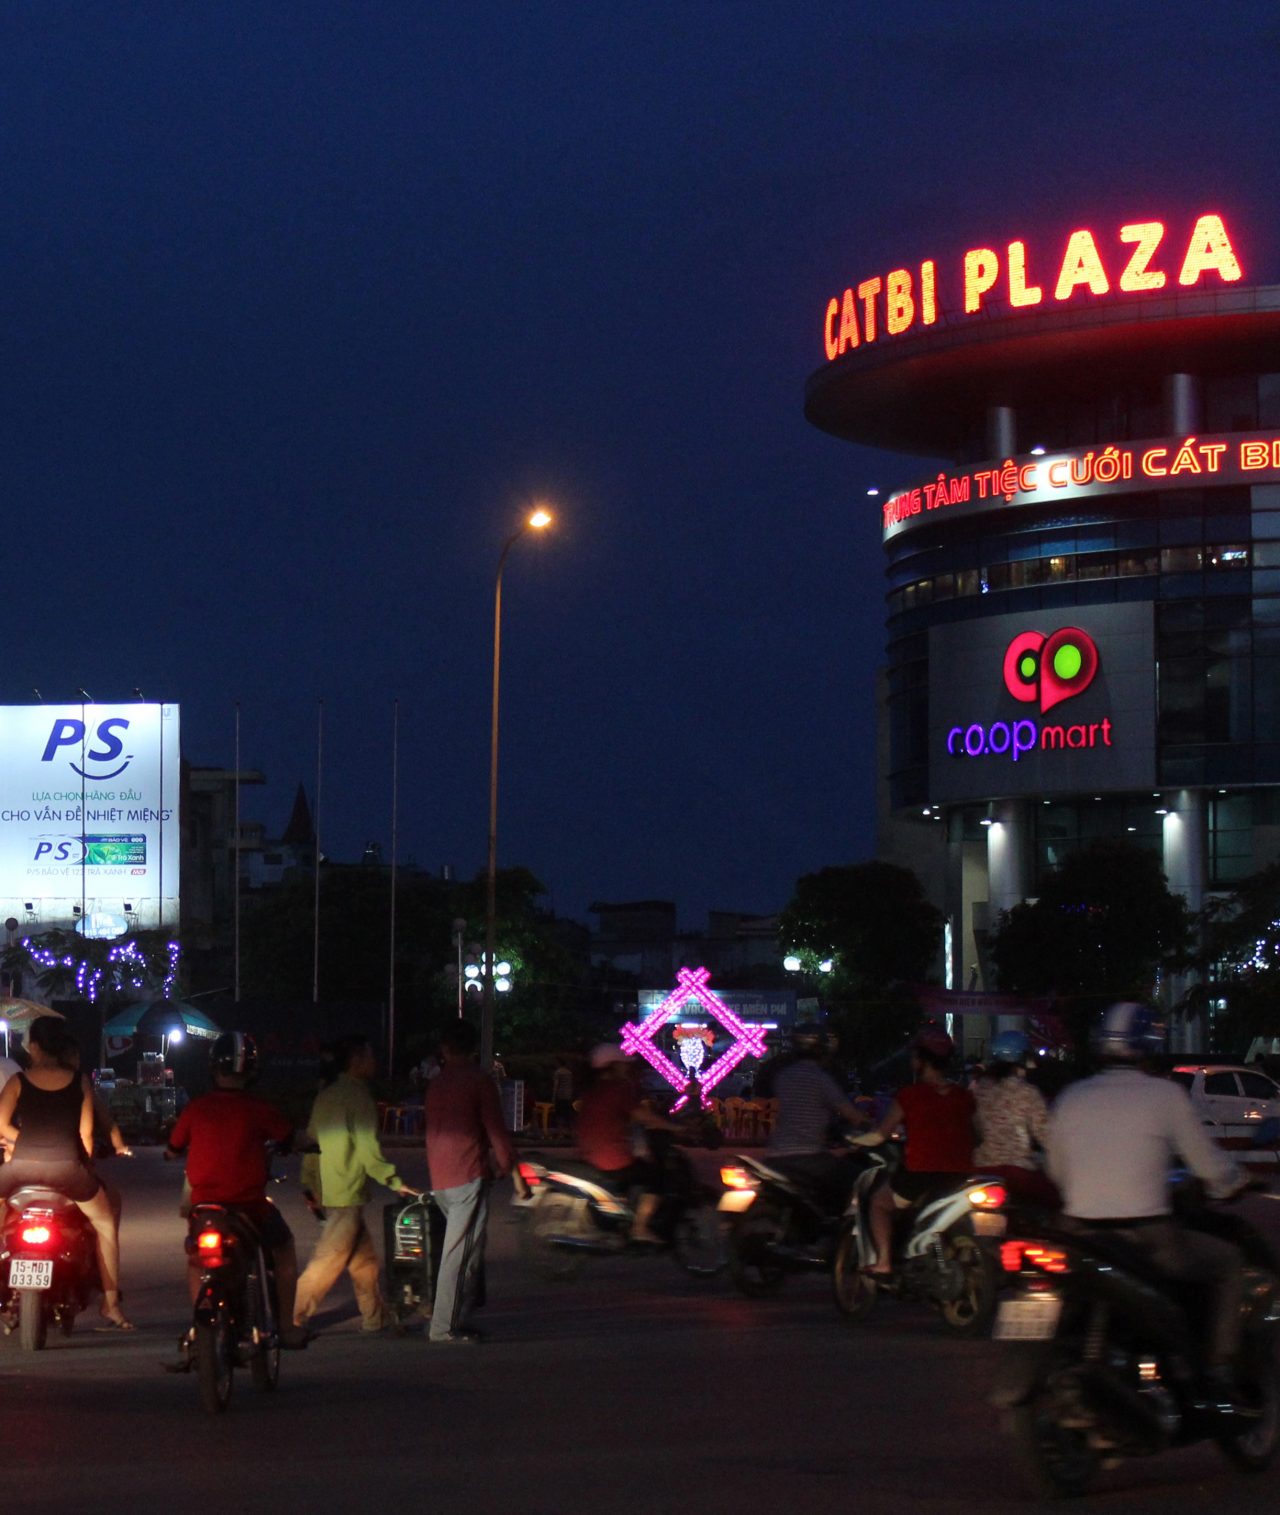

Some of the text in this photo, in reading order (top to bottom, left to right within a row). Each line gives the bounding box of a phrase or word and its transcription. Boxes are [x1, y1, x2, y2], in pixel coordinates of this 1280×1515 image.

[825, 214, 1242, 360] CATBI PLAZA
[883, 437, 1280, 528] TRUNG TÂM TIỆC CƯỚI CÁT BI
[1, 810, 31, 822] CHO
[34, 805, 62, 821] VẤN
[86, 807, 123, 824] NHIỆT
